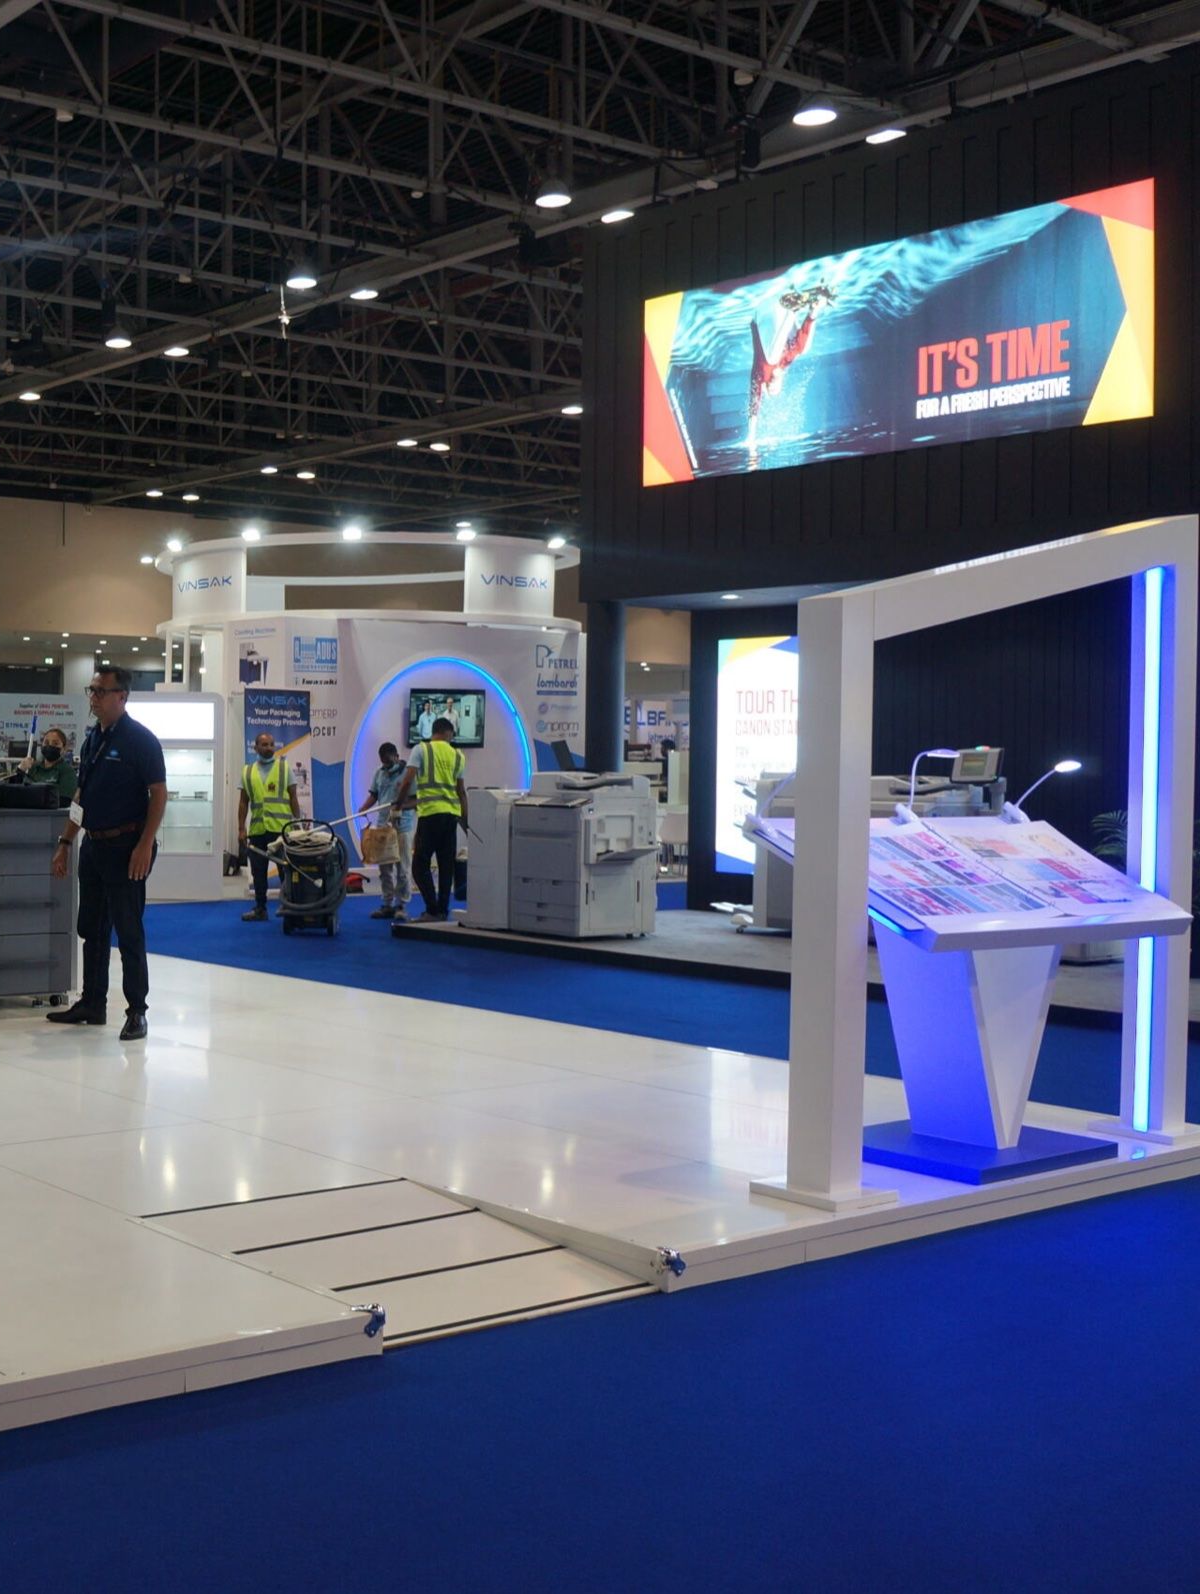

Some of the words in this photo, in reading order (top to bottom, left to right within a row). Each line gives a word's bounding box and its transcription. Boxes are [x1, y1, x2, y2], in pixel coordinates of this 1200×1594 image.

[917, 337, 979, 396] IT'S
[985, 319, 1071, 384] TIME
[916, 397, 941, 420] FOR
[940, 395, 950, 416] A
[990, 376, 1071, 408] PERSPECTIVE
[177, 575, 232, 593] VINSAK
[481, 574, 548, 589] VINSAK
[248, 695, 307, 705] VINSAK
[736, 690, 775, 714] TOUR
[781, 689, 799, 714] TH
[247, 717, 281, 726] Technology
[283, 718, 308, 726] Provider
[270, 708, 301, 718] Packaging
[735, 719, 771, 737] CANON
